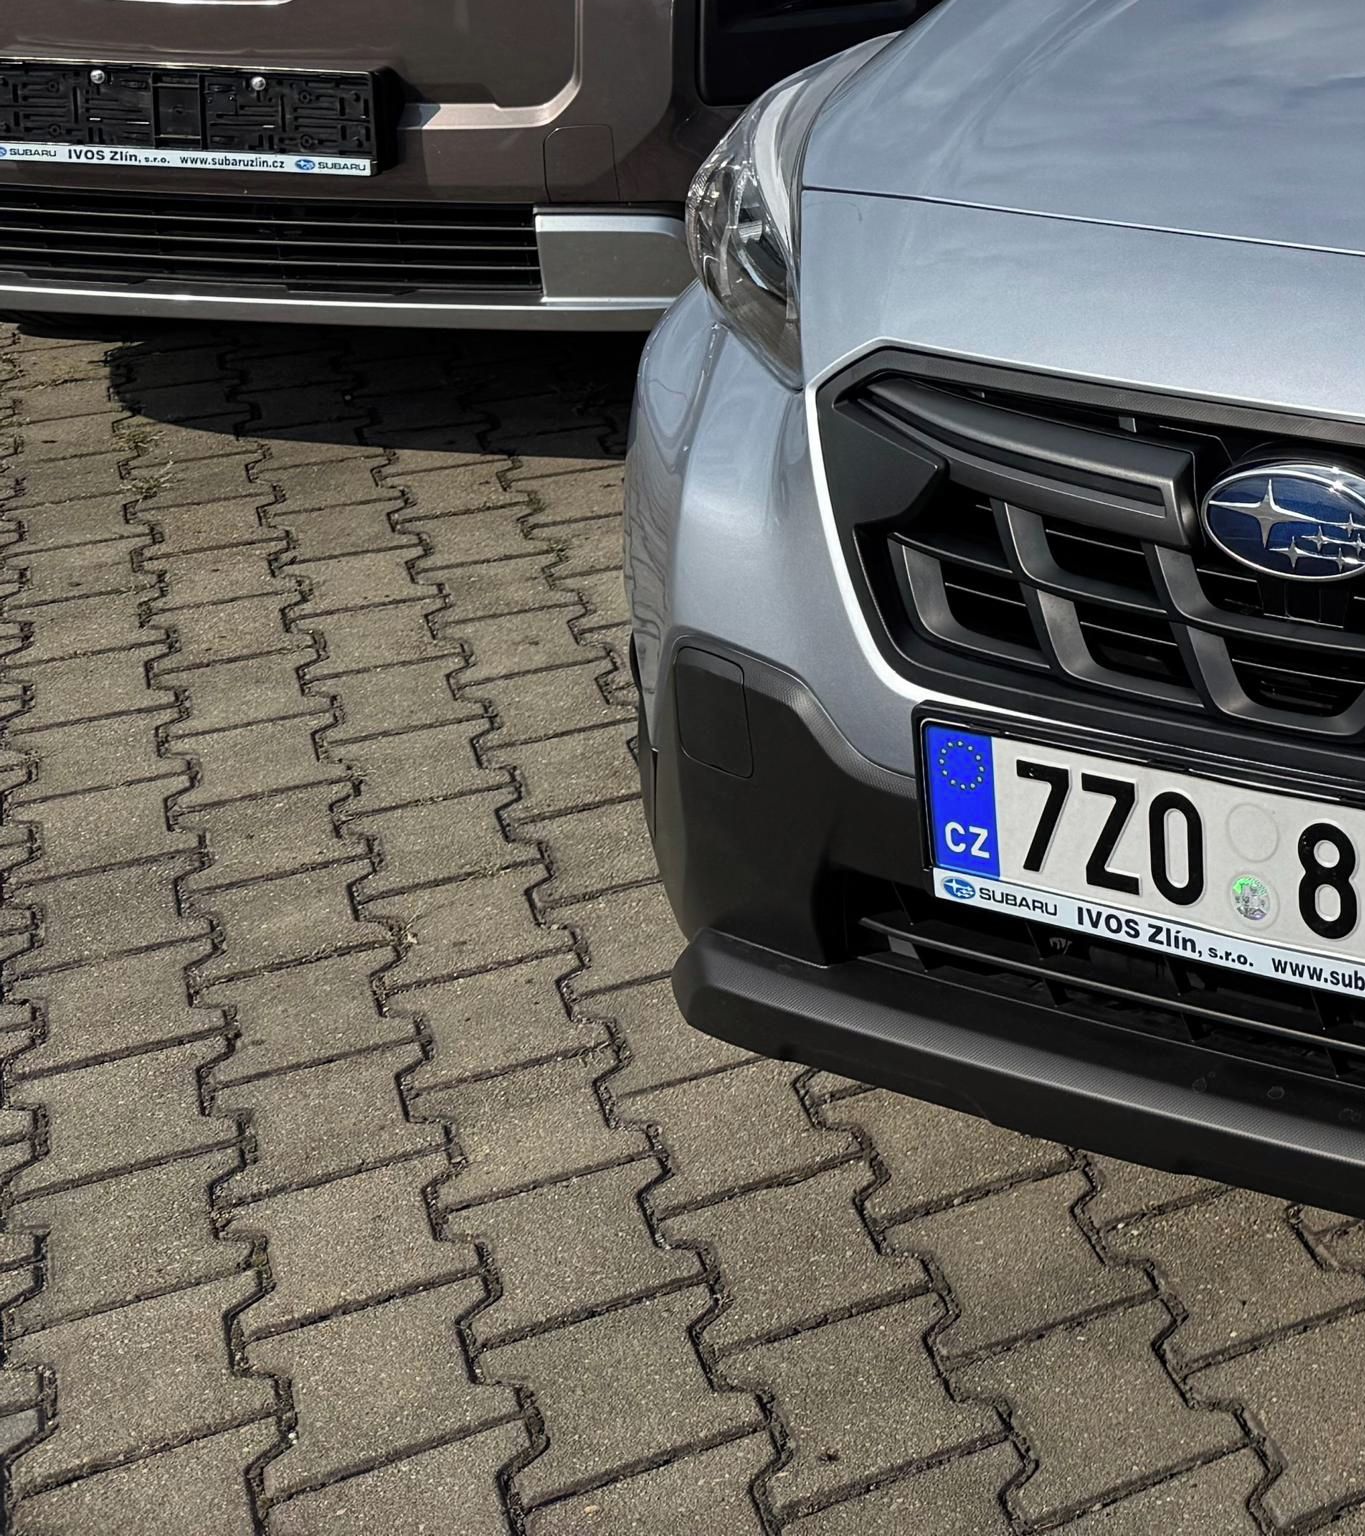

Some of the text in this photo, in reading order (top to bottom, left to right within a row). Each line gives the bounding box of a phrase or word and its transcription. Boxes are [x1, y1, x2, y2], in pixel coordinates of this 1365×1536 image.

[9, 148, 366, 171] SUBARU IVOS Zlín, s.r.o. www.subaruzlin.cz SUBARU
[944, 821, 990, 859] CZ
[979, 887, 1058, 916] SUBARU
[1077, 906, 1141, 939] IVOS
[1147, 923, 1203, 957] Zlín,
[1208, 946, 1254, 967] s.r.o.
